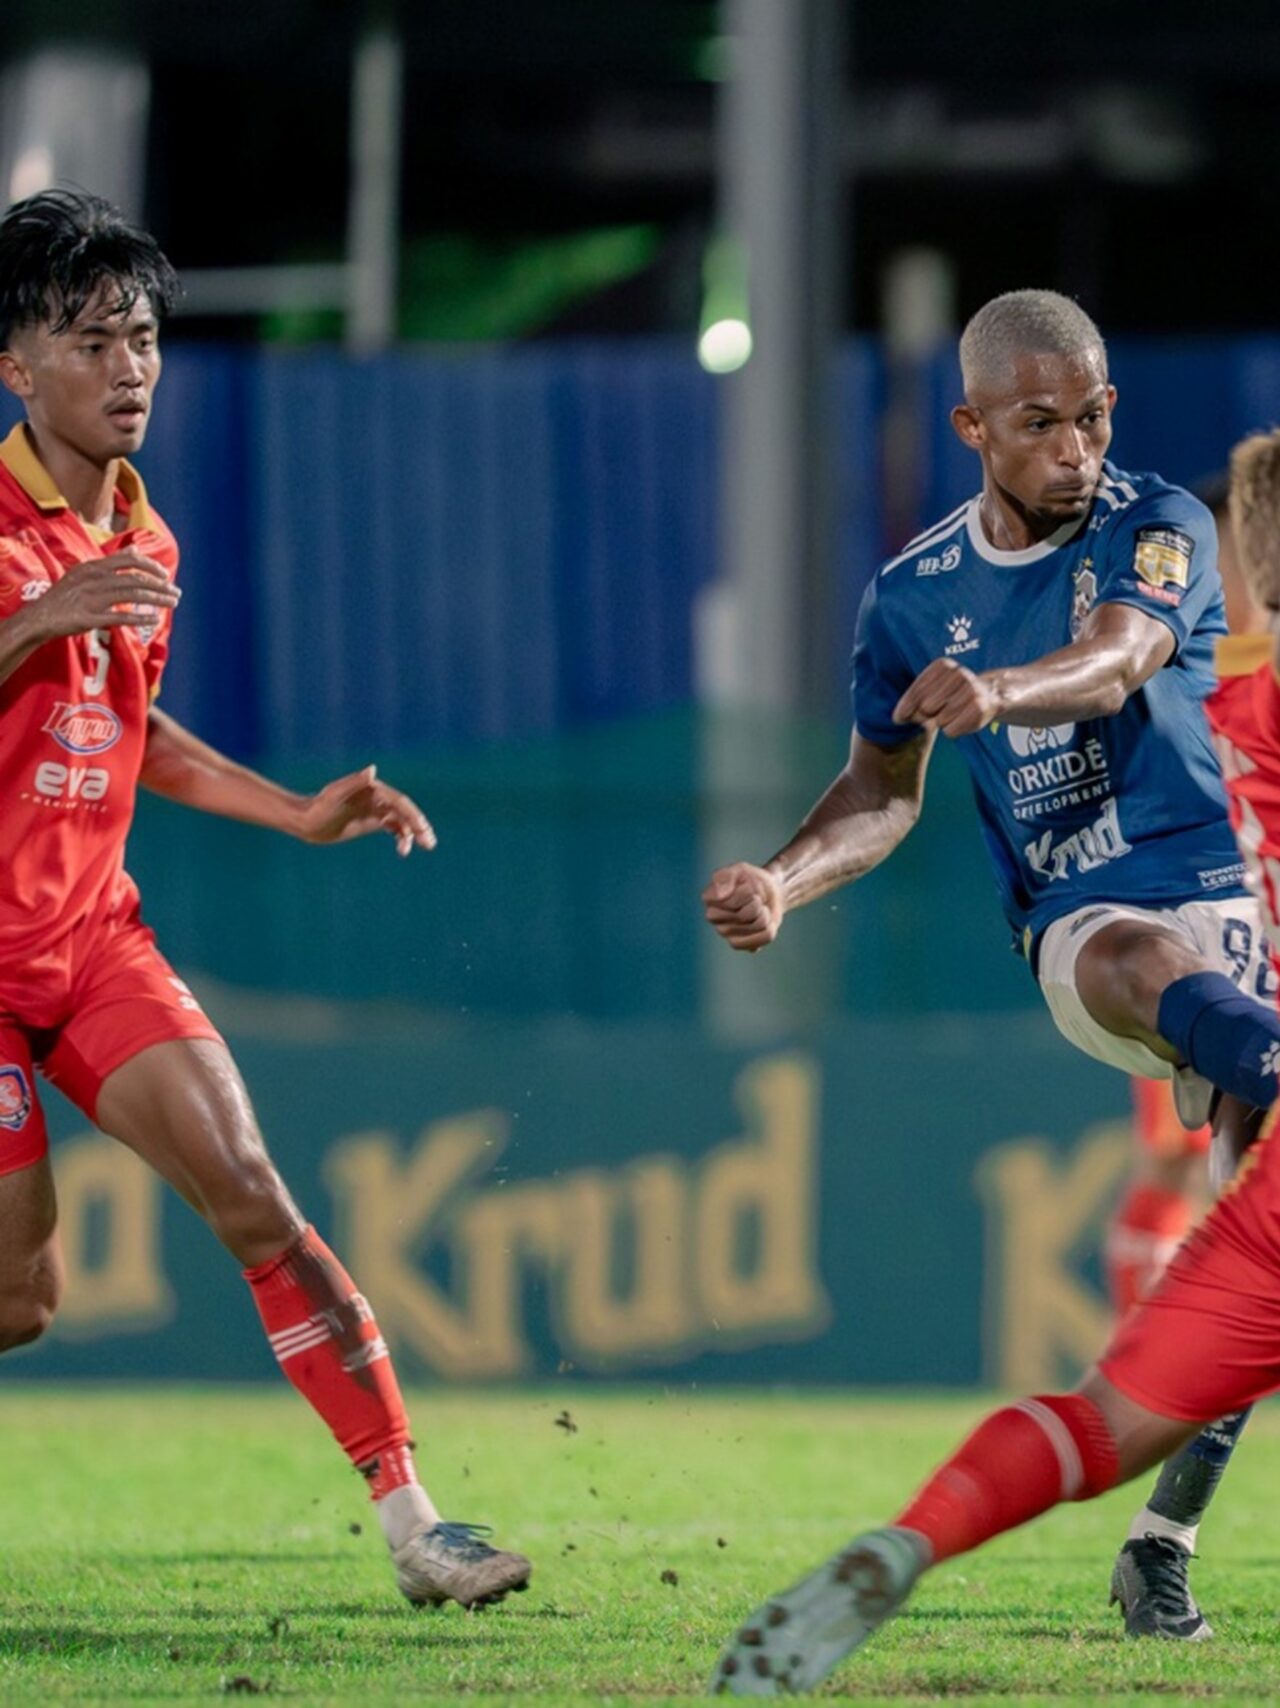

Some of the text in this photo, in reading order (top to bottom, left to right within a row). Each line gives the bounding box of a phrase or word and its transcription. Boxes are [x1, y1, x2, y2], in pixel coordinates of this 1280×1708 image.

[83, 628, 111, 696] 5
[34, 761, 111, 801] eva
[327, 1056, 830, 1378] Krud
